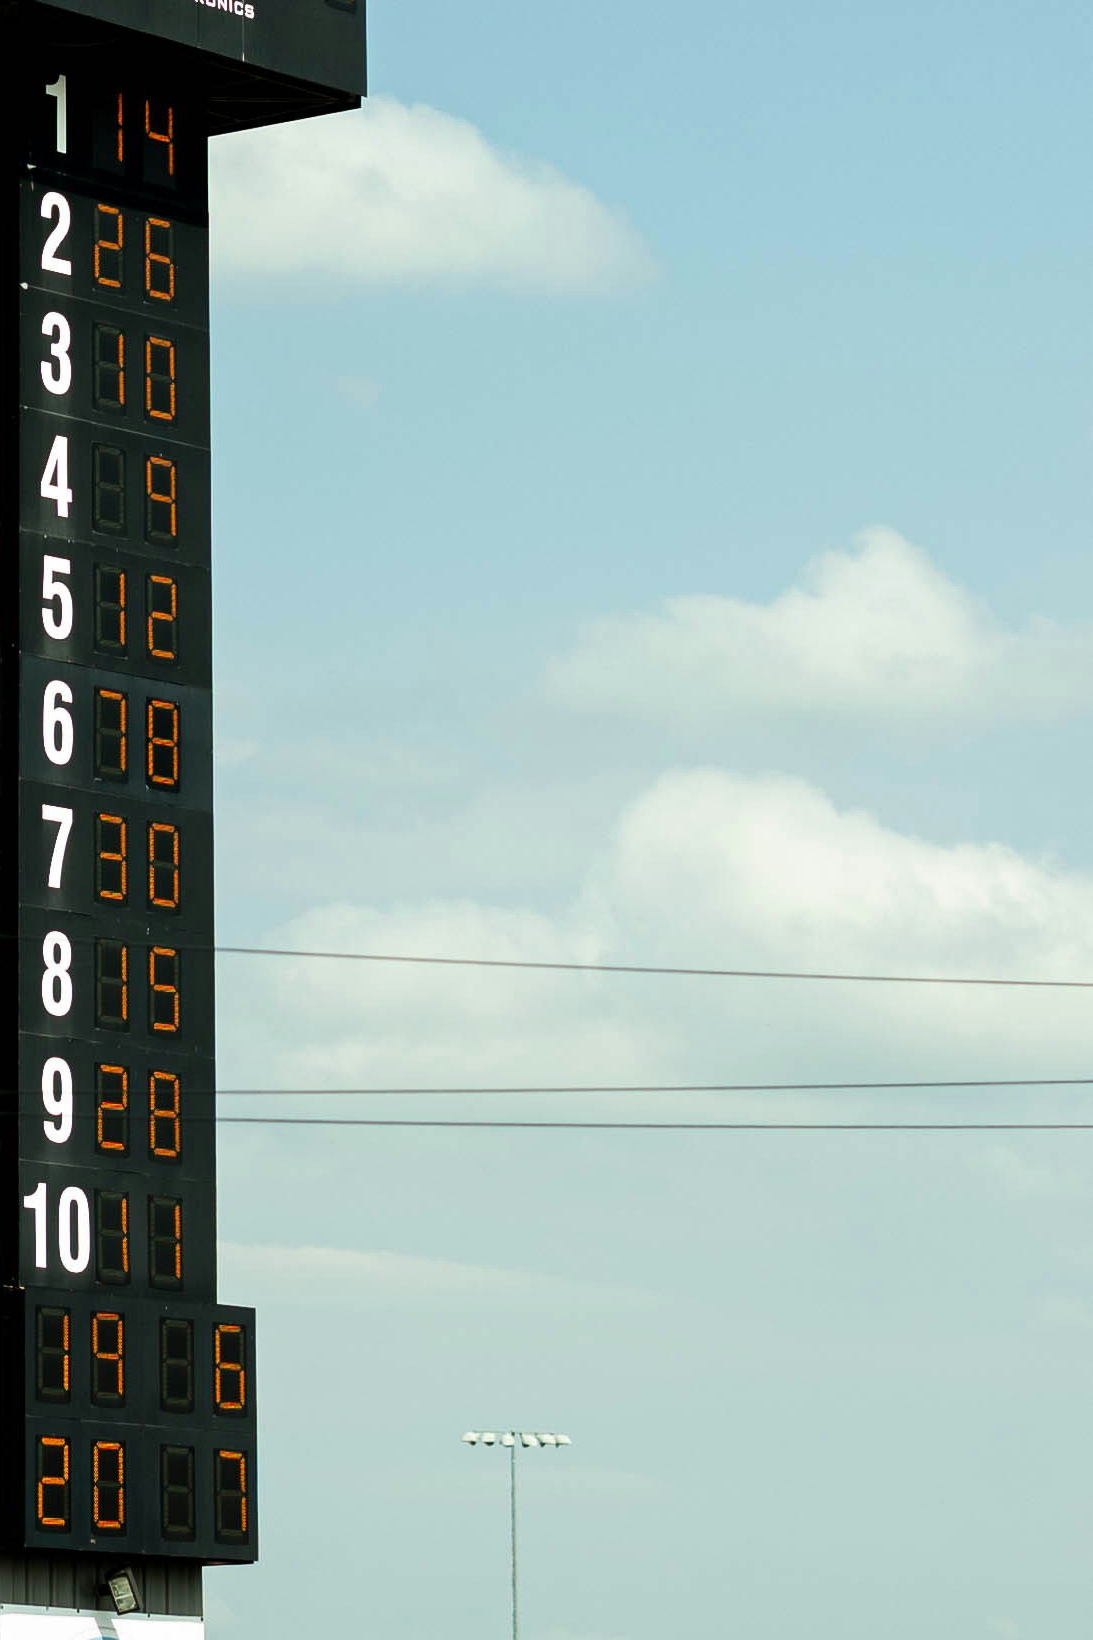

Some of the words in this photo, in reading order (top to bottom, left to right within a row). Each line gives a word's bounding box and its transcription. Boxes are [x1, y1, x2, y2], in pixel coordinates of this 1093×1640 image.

[45, 74, 67, 154] 1
[117, 93, 174, 175] 14
[40, 191, 72, 276] 2
[93, 203, 176, 302] 26
[40, 311, 72, 396] 3
[118, 333, 176, 420] 10
[40, 434, 73, 519] 4
[146, 455, 177, 537] 9
[41, 554, 74, 640] 5
[118, 572, 178, 659] 12
[42, 679, 74, 766] 6
[98, 689, 179, 786] 78
[41, 803, 74, 889] 7
[98, 813, 180, 909] 30
[41, 930, 73, 1017] 8
[120, 945, 180, 1032] 15
[41, 1056, 74, 1144] 9
[96, 1064, 181, 1158] 28
[23, 1182, 91, 1274] 10
[120, 1197, 182, 1279] 11
[62, 1312, 124, 1396] 19
[214, 1324, 246, 1410] 6
[37, 1436, 125, 1529] 20
[219, 1449, 247, 1532] 7
